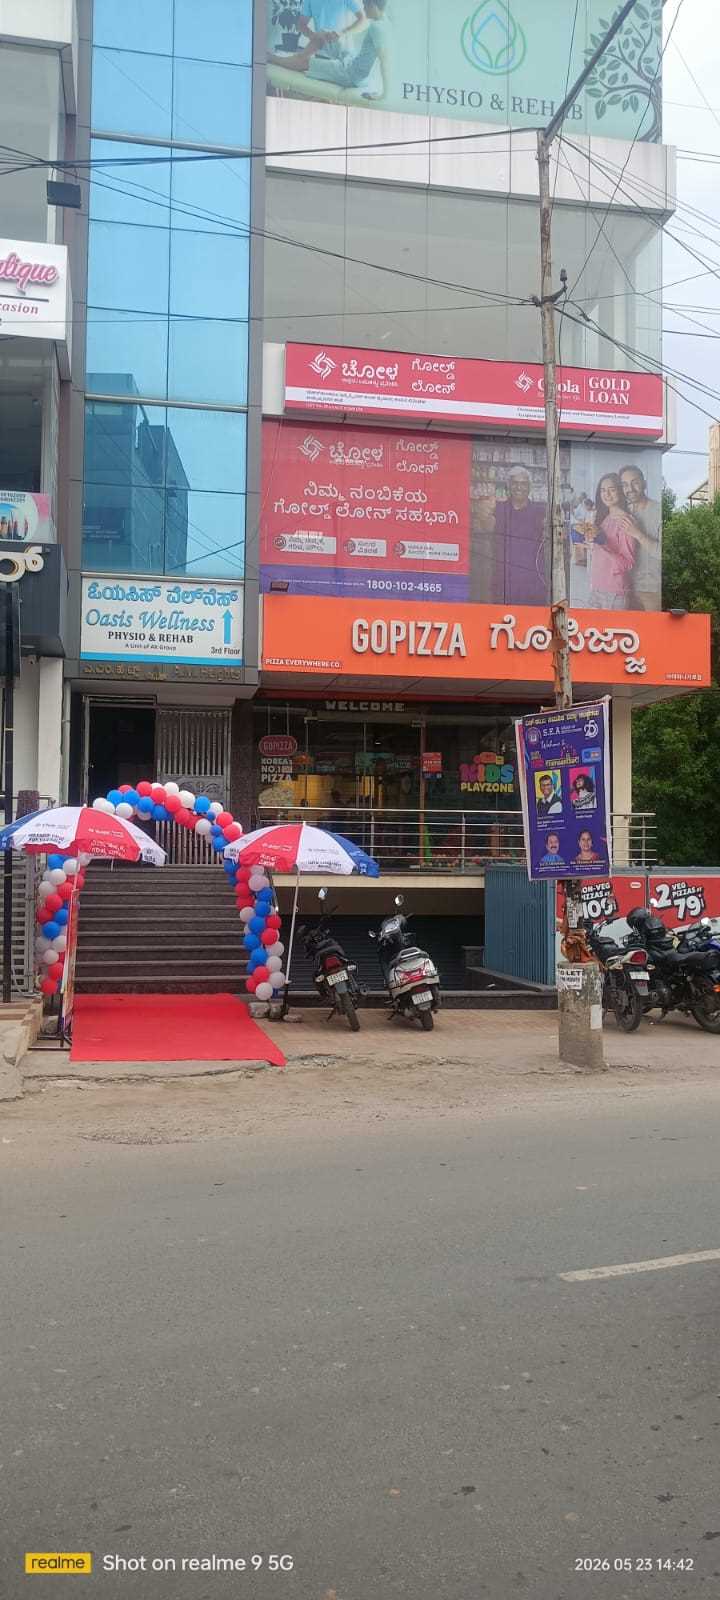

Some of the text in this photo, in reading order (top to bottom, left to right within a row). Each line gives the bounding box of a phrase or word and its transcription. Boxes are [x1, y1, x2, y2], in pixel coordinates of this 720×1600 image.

[402, 83, 583, 120] PHYSIO & REHB
[537, 378, 580, 394] Cola
[588, 376, 631, 391] GOLD
[589, 391, 630, 405] LOAN
[303, 481, 428, 503] ನಿಮ್ಮ ನಂಬಿಕೆಯ
[273, 498, 459, 525] ಗೋಲ್ಡ್ ಲೋನ್ ಸಹಭಾಗಿ
[367, 579, 442, 593] 1800-102-4565
[86, 608, 215, 632] Oasis Wellness
[108, 631, 193, 643] PHYSIO & REHAB
[351, 618, 467, 657] GOPIZZA
[211, 647, 241, 655] 3rd Floor
[325, 701, 405, 712] WELCOME
[261, 774, 292, 783] PIZZA
[460, 782, 514, 793] PLAYZONE
[582, 883, 610, 893] ON-VEG
[656, 883, 673, 908] 2
[672, 882, 686, 890] VEG
[672, 887, 696, 898] PIZZAS
[582, 891, 604, 900] IZZAS
